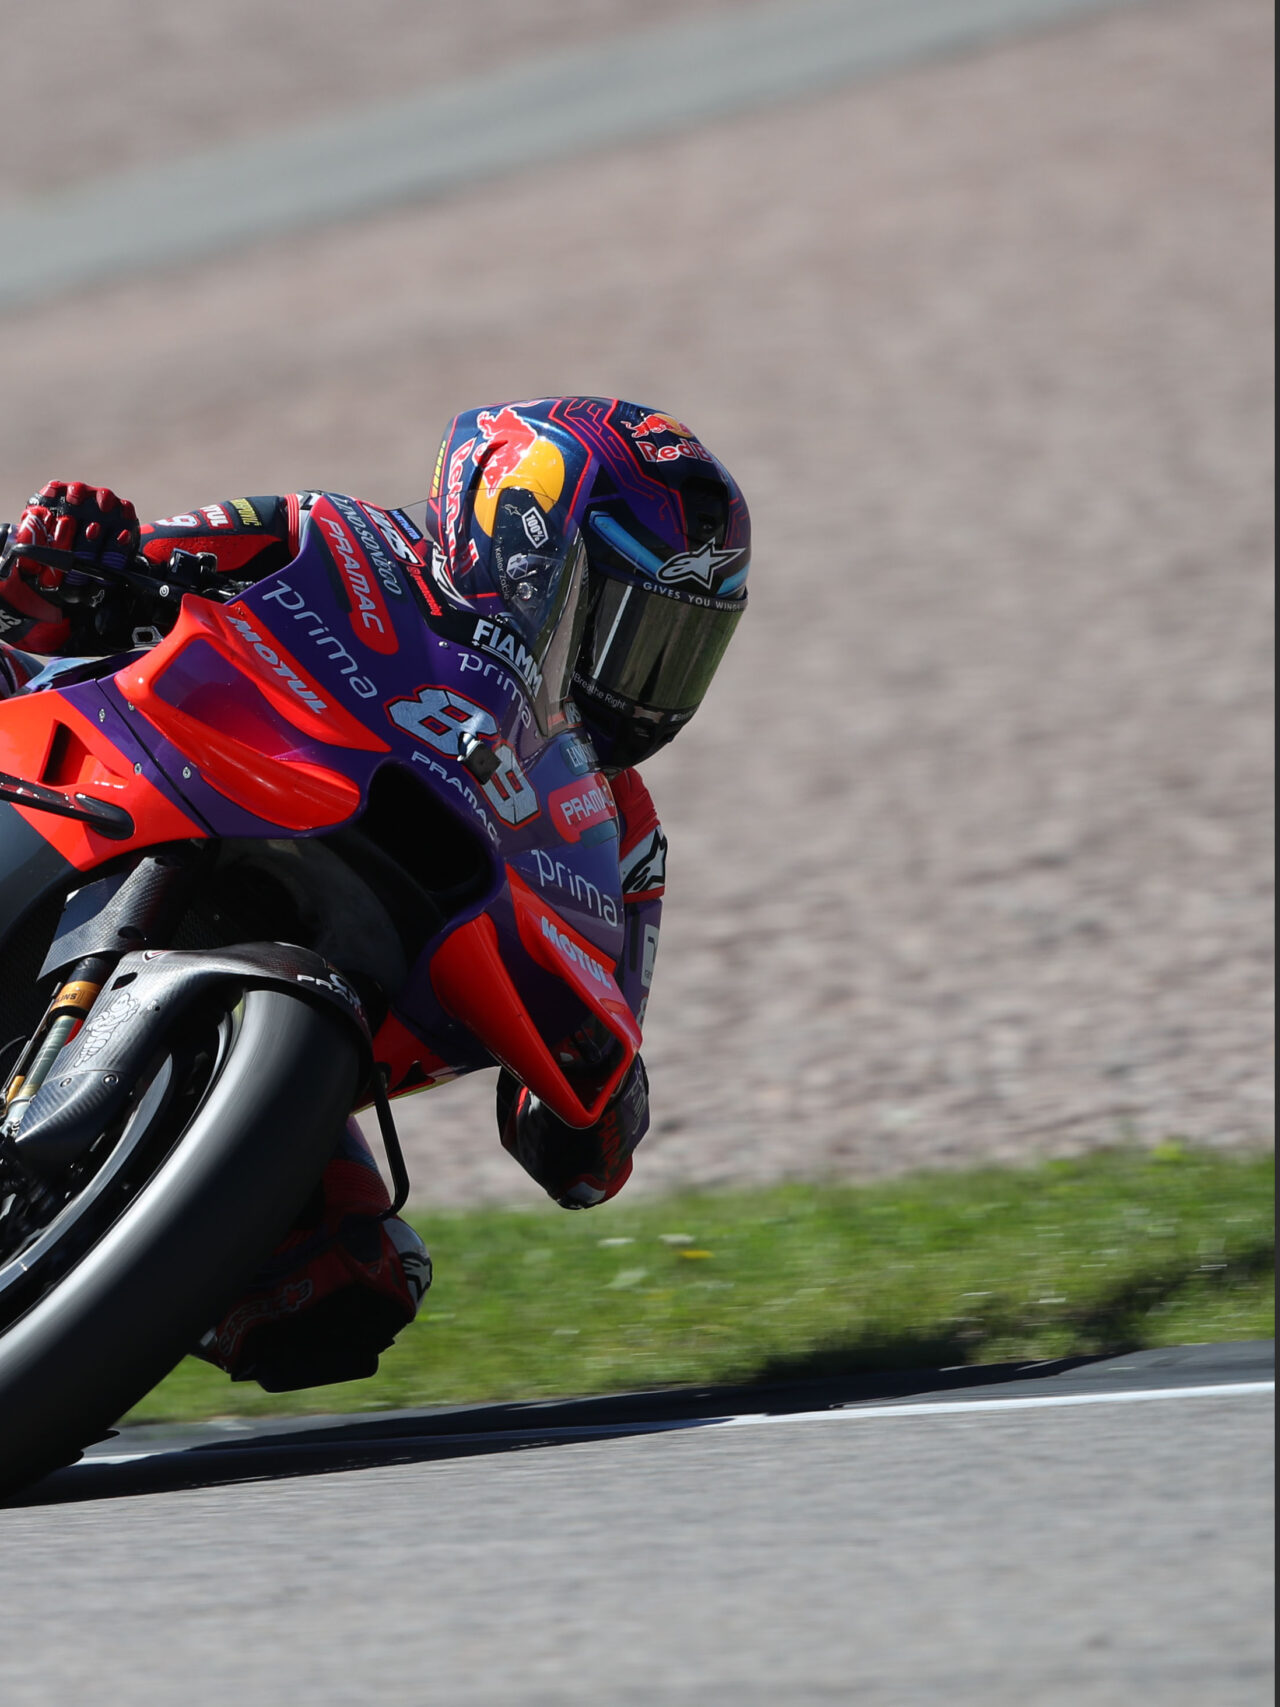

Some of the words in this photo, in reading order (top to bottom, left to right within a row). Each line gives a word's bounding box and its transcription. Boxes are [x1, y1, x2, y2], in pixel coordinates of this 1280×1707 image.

[634, 437, 698, 462] Red
[524, 513, 545, 544] 100%
[320, 516, 386, 634] PRAMAC
[642, 581, 681, 600] GIVES
[687, 594, 711, 607] YOU
[226, 615, 329, 715] MOTUL
[262, 580, 378, 699] prima
[472, 618, 543, 697] FIAMM
[457, 652, 531, 729] prima
[605, 694, 627, 711] Right
[386, 687, 540, 828] 89
[411, 750, 499, 842] PRAMAC
[530, 848, 618, 928] prima
[540, 915, 612, 990] MOTUL
